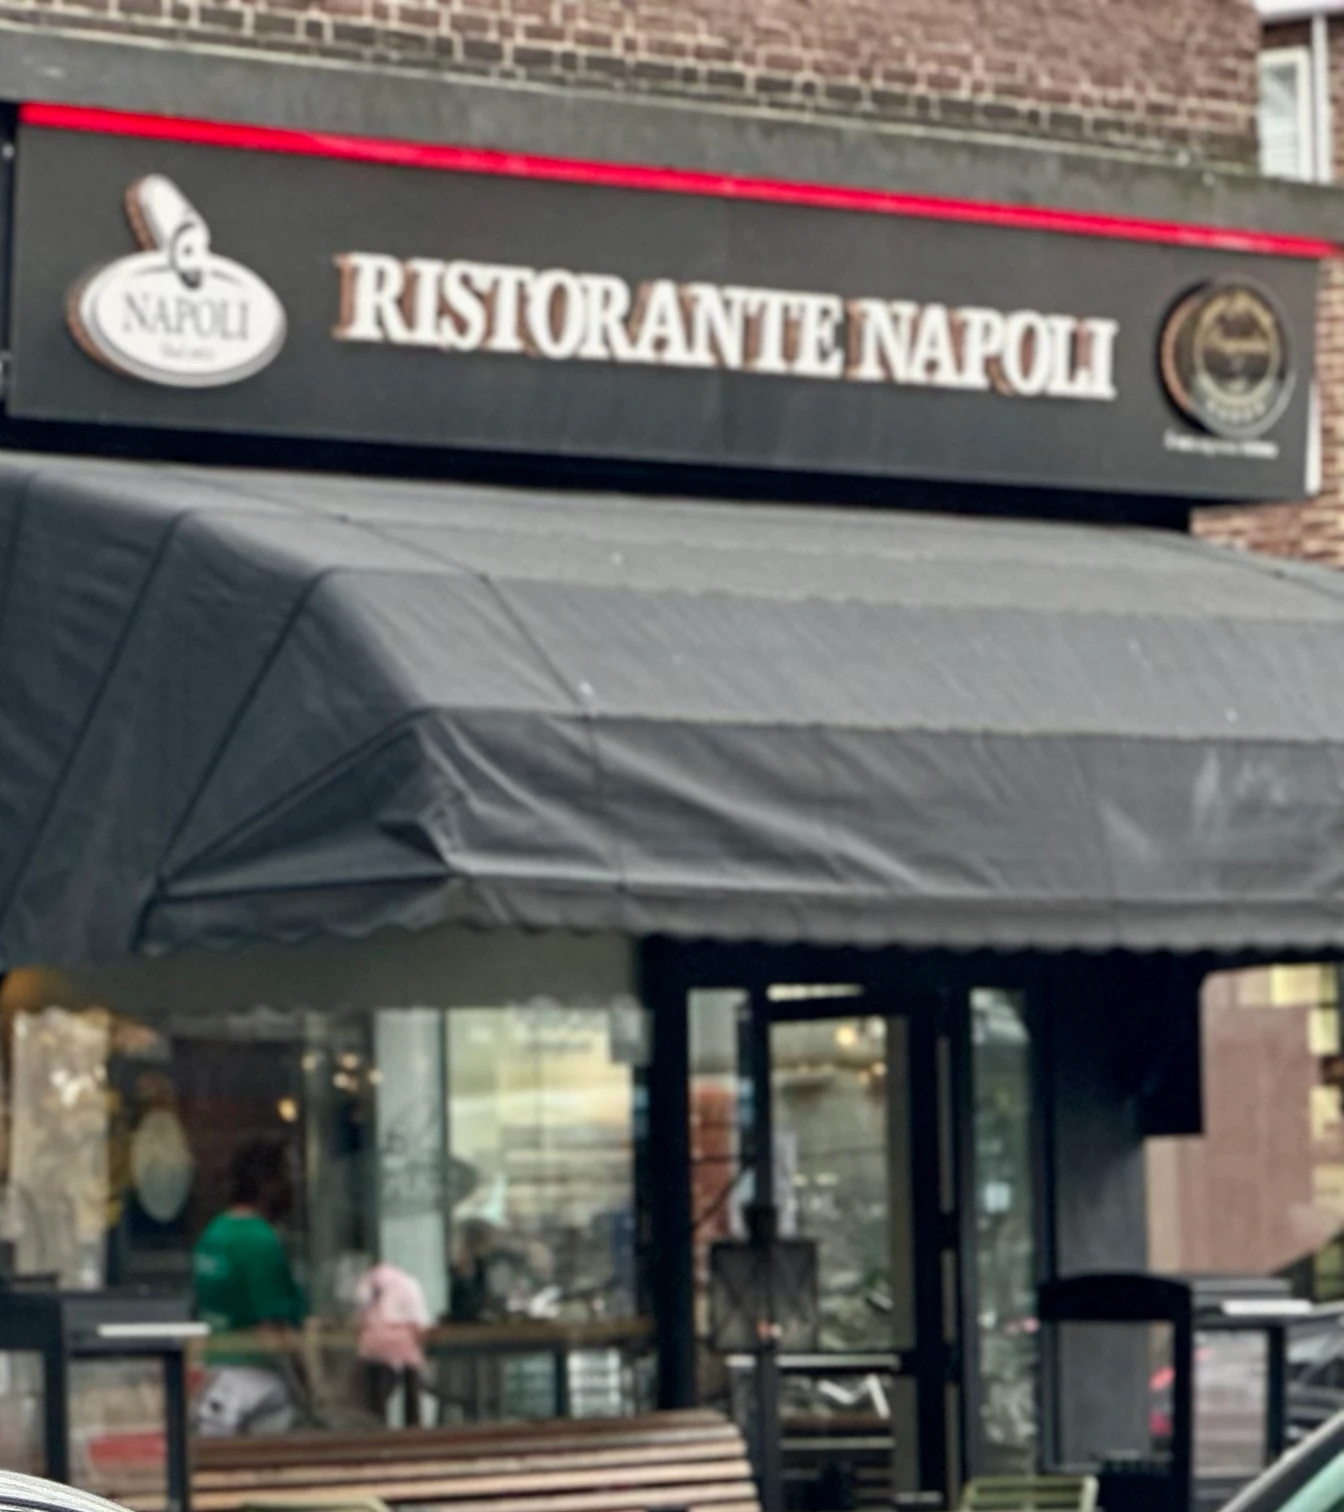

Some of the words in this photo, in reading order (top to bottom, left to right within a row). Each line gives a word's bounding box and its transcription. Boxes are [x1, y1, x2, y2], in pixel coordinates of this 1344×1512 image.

[122, 291, 250, 341] NAPOLI
[334, 252, 845, 379] RISTORANTE
[848, 297, 1119, 401] NAPOLI
